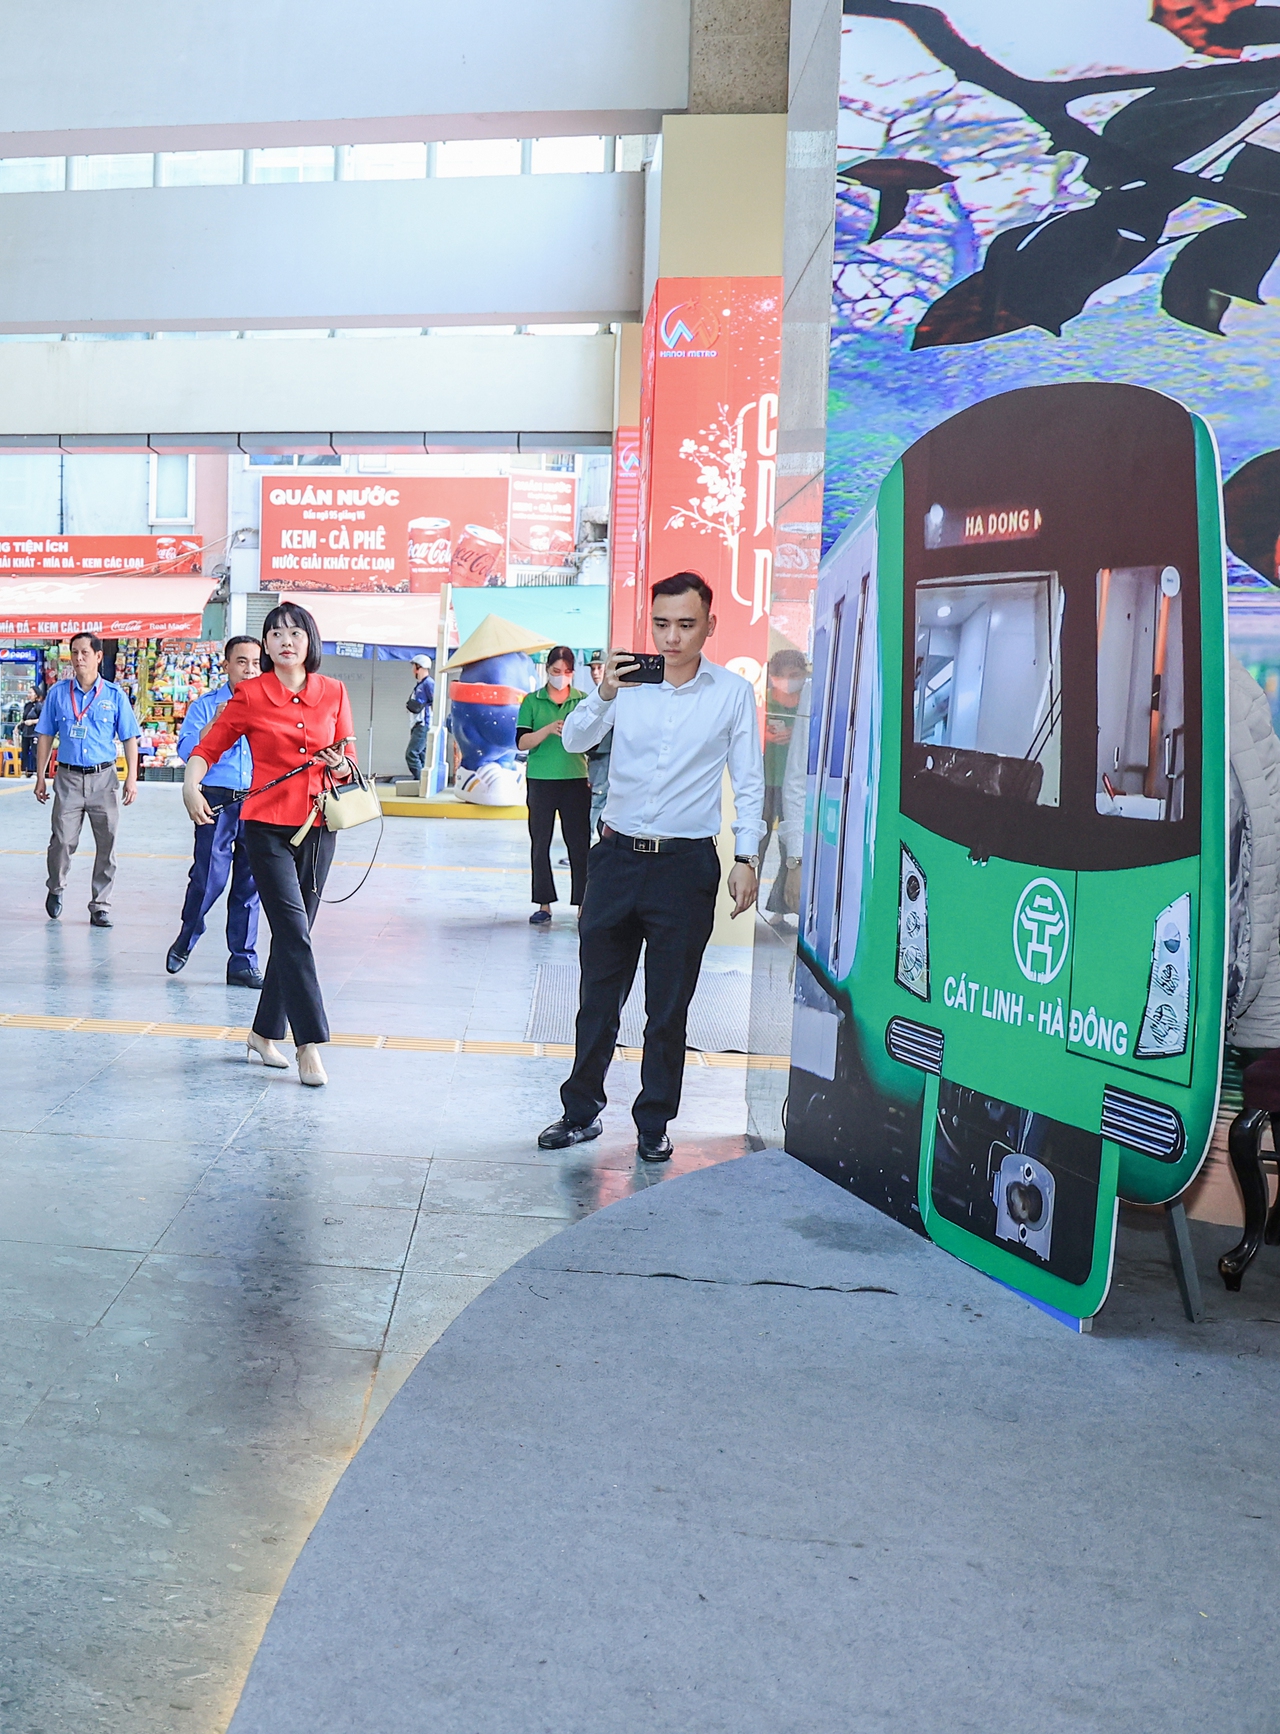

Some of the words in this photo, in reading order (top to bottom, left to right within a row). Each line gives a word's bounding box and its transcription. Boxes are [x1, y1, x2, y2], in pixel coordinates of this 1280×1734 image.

[660, 350, 686, 358] HANOI
[687, 350, 718, 358] METRO
[269, 485, 333, 506] QUÁN
[336, 485, 400, 506] NƯỚC
[965, 514, 984, 537] HA
[988, 509, 1029, 535] DONG
[281, 529, 317, 549] KEM
[328, 525, 350, 549] CÀ
[353, 525, 386, 549] PHÊ
[13, 540, 43, 555] TIỆN
[45, 539, 69, 553] ÍCH
[13, 556, 36, 568] KHÁT
[43, 556, 60, 568] MÍA
[62, 556, 75, 568] ĐÁ
[82, 557, 102, 568] KEM
[104, 556, 122, 568] CÁC
[124, 557, 145, 570] LOẠI
[272, 553, 300, 569] NƯỚC
[301, 553, 322, 569] GIẢI
[323, 554, 350, 570] KHÁT
[351, 554, 370, 570] CÁC
[372, 557, 395, 573] LOẠI
[38, 621, 58, 633] KEM
[61, 619, 79, 633] CÁC
[82, 621, 102, 635] LOẠI
[149, 622, 166, 630] Real
[168, 622, 191, 631] Magic
[10, 651, 31, 659] pepsi
[943, 972, 979, 1013] CÁT
[981, 986, 1024, 1026] LINH
[1038, 997, 1065, 1039] HÀ
[1069, 1006, 1128, 1056] ĐÔNG
